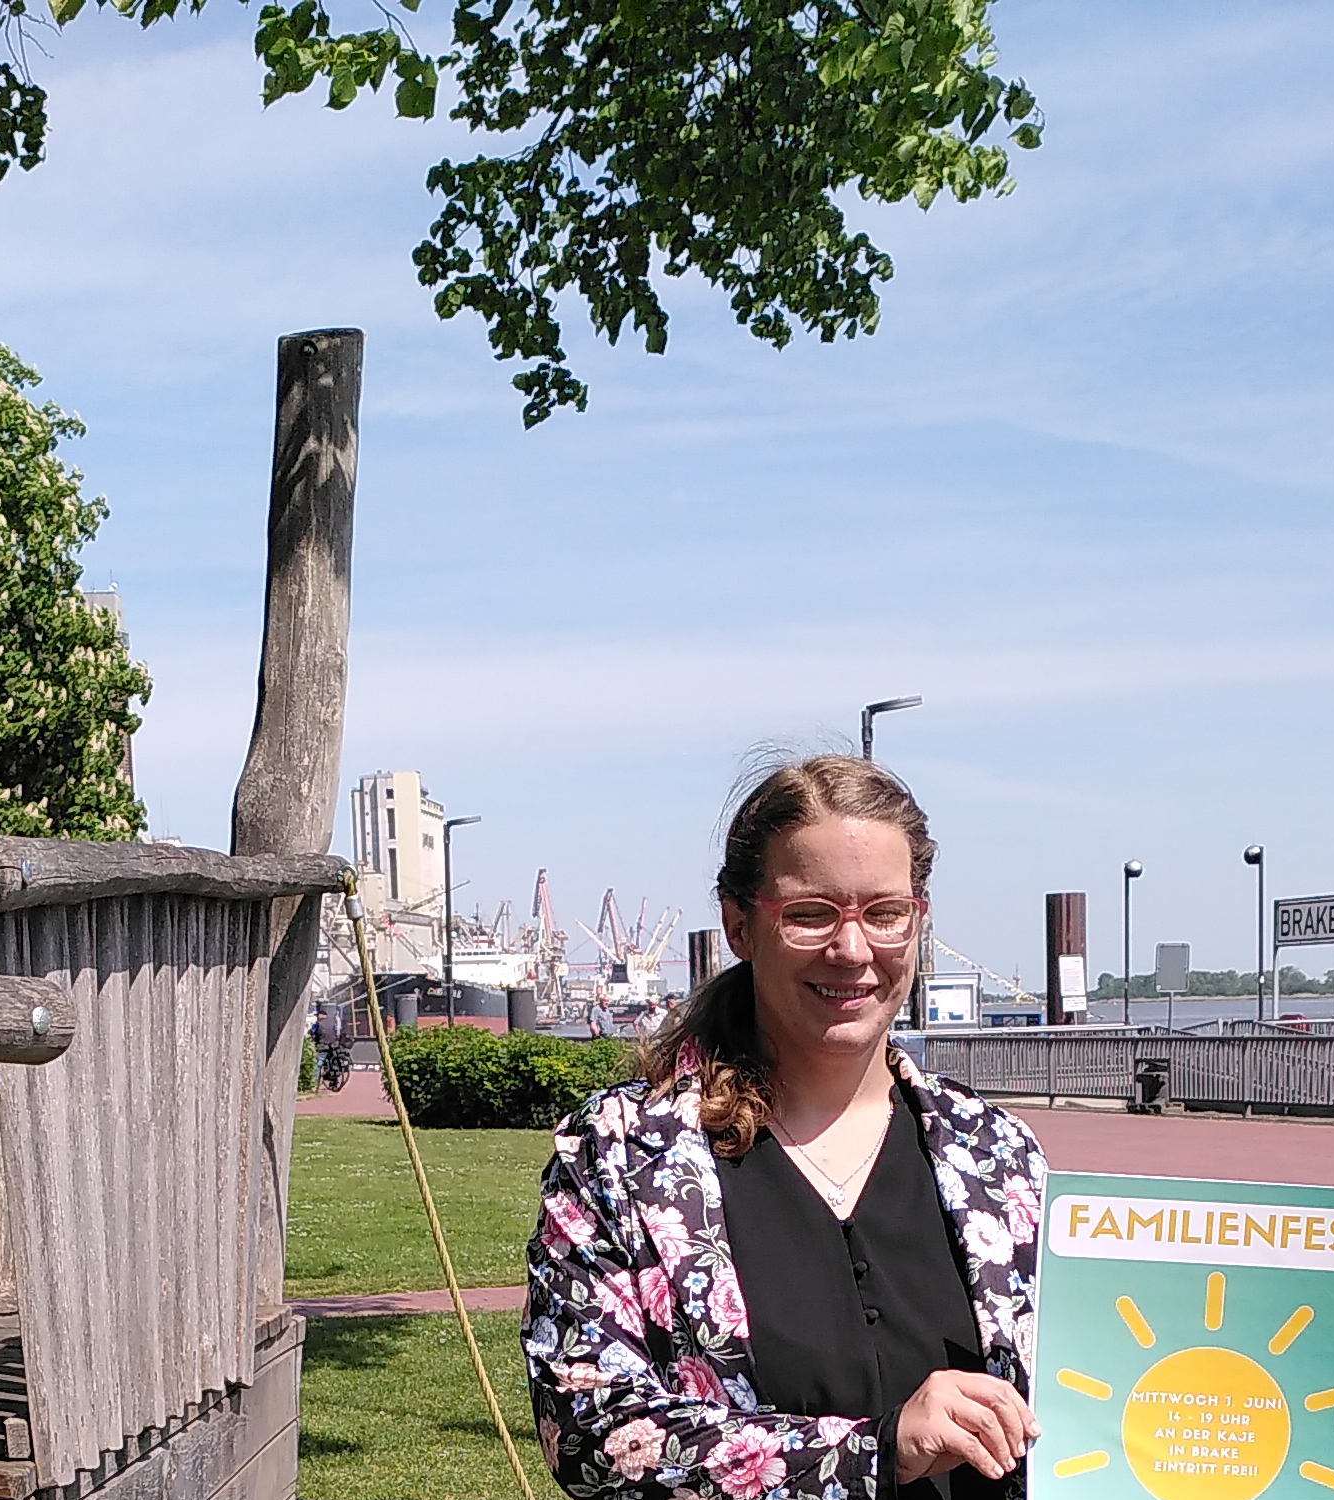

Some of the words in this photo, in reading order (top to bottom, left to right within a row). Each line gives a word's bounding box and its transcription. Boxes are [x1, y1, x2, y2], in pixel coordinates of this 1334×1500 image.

[1132, 1392, 1218, 1406] MITTWOCH
[1243, 1397, 1282, 1410] JUNI
[1168, 1411, 1181, 1422] 14
[1200, 1412, 1213, 1423] 19
[1220, 1414, 1250, 1426] UHR
[1154, 1428, 1175, 1438] AN
[1182, 1429, 1210, 1440] DER
[1217, 1431, 1255, 1442] KAJE
[1169, 1445, 1185, 1456] IN
[1192, 1446, 1238, 1459] BRAKE
[1154, 1461, 1216, 1474] EINTRITT
[1223, 1465, 1258, 1476] FREI!
